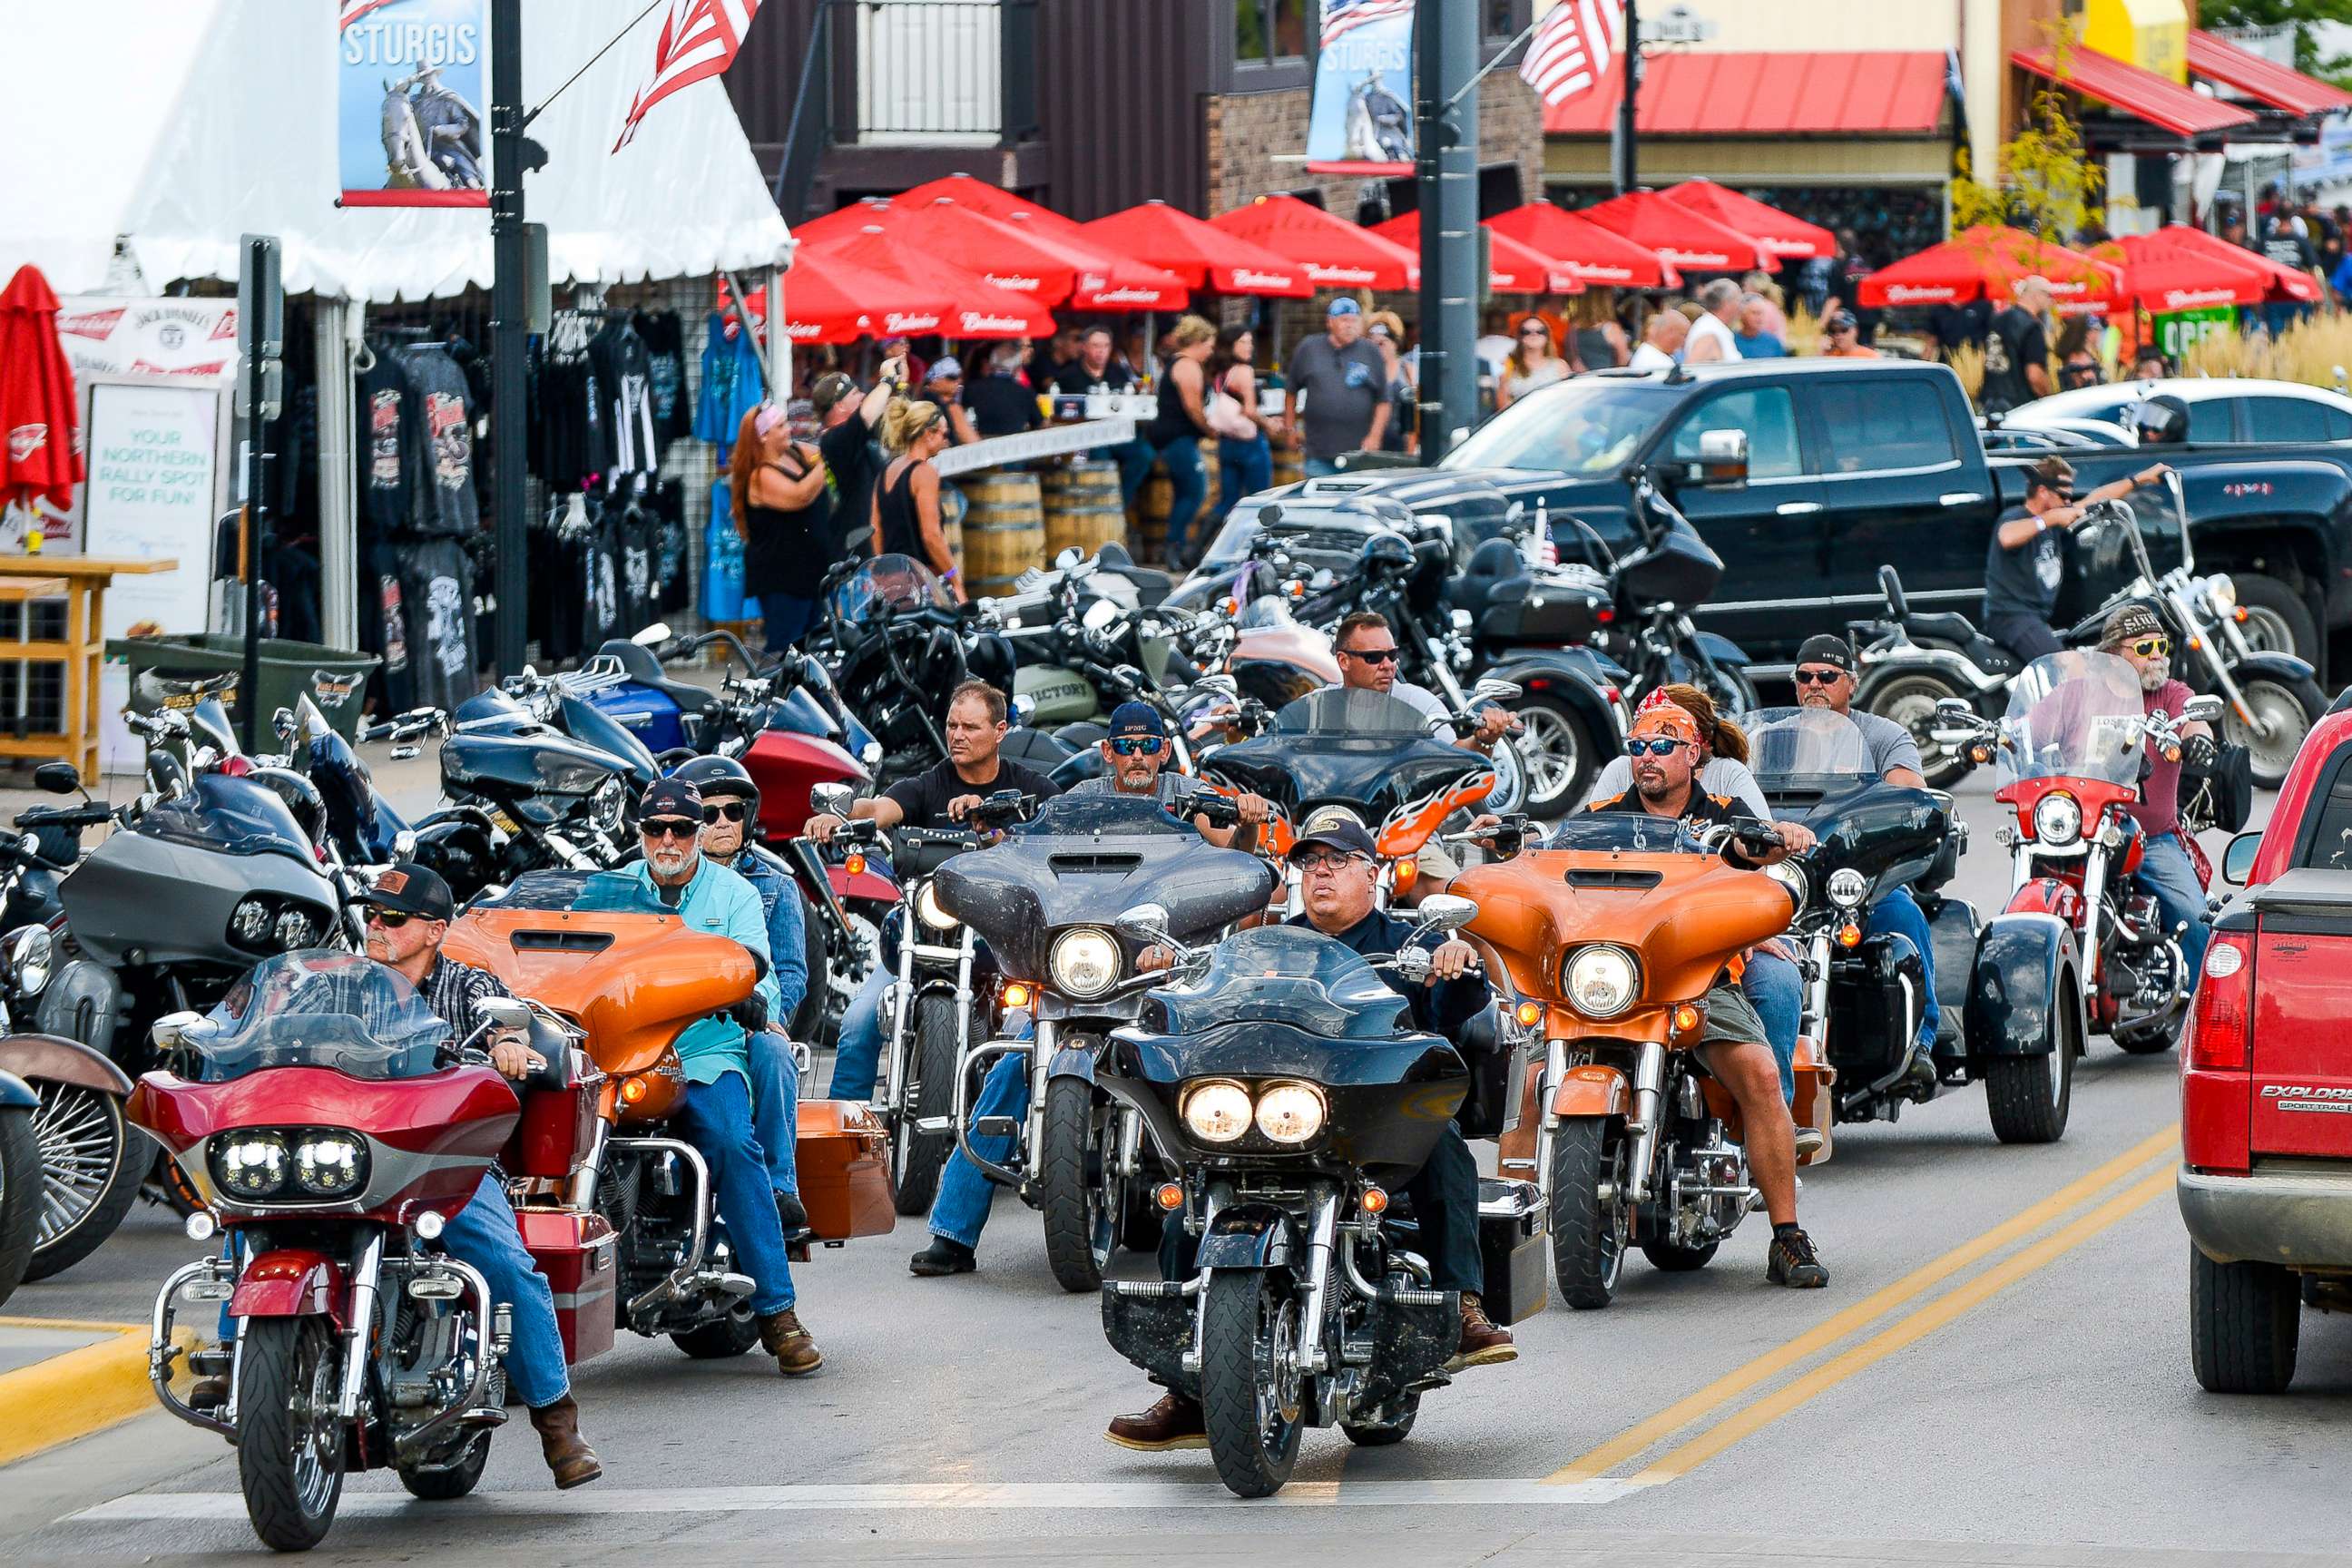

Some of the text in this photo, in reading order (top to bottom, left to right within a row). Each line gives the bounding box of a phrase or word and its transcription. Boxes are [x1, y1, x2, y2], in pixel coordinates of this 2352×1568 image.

[344, 22, 476, 66] STURGIS
[1324, 42, 1406, 72] STURGIS
[130, 429, 181, 445] YOUR
[102, 448, 207, 466] NORTHERN
[99, 467, 210, 486] RALLY SPOT
[109, 486, 148, 503] FOR
[2279, 1102, 2346, 1112] SPORT TRAC
